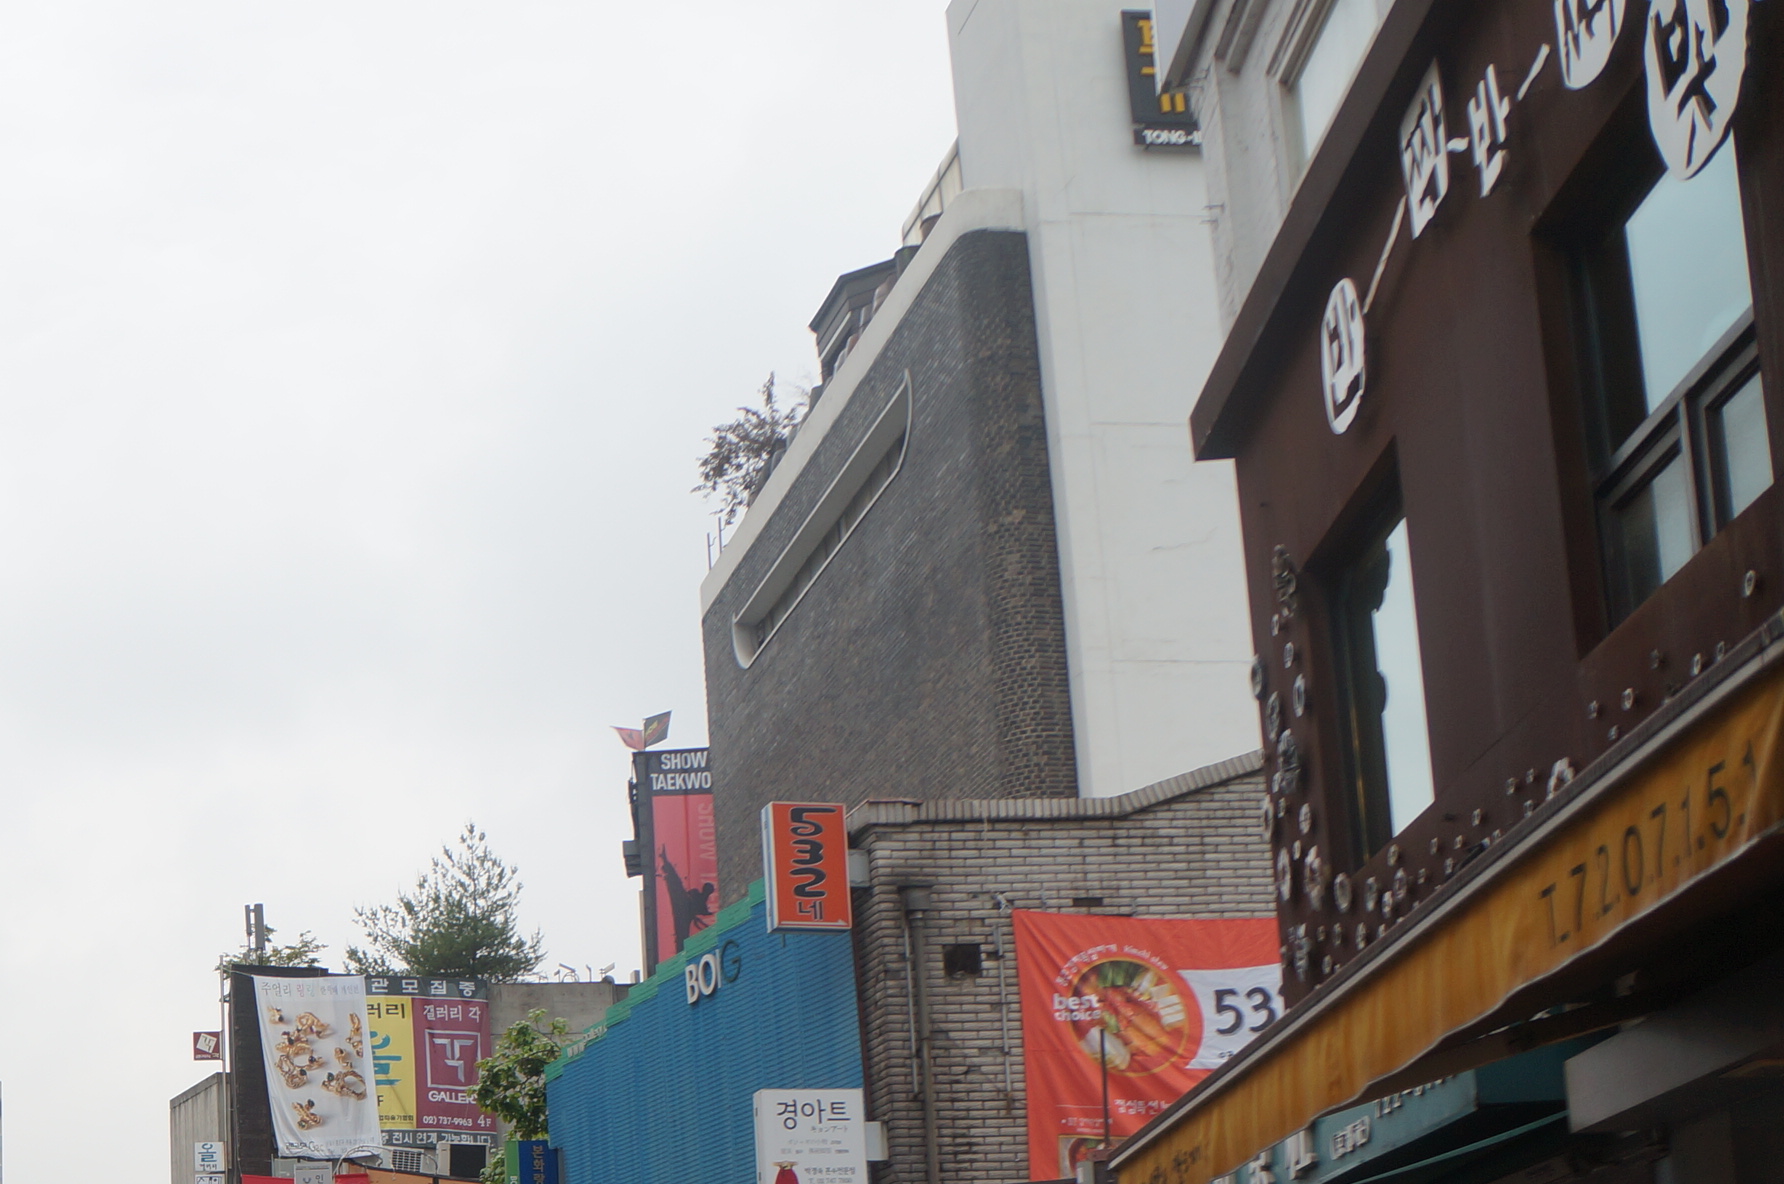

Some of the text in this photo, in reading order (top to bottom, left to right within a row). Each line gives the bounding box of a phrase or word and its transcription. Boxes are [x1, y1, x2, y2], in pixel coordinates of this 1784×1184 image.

[660, 752, 708, 770] SHOW
[1053, 993, 1101, 1010] best
[423, 1004, 481, 1023] 갤러리 각
[1054, 1010, 1103, 1021] choice
[438, 1116, 473, 1127] 737-9963
[477, 1115, 492, 1128] 4F
[776, 1098, 851, 1130] 경아트
[391, 1133, 414, 1144] 전시
[198, 1142, 217, 1163] 올
